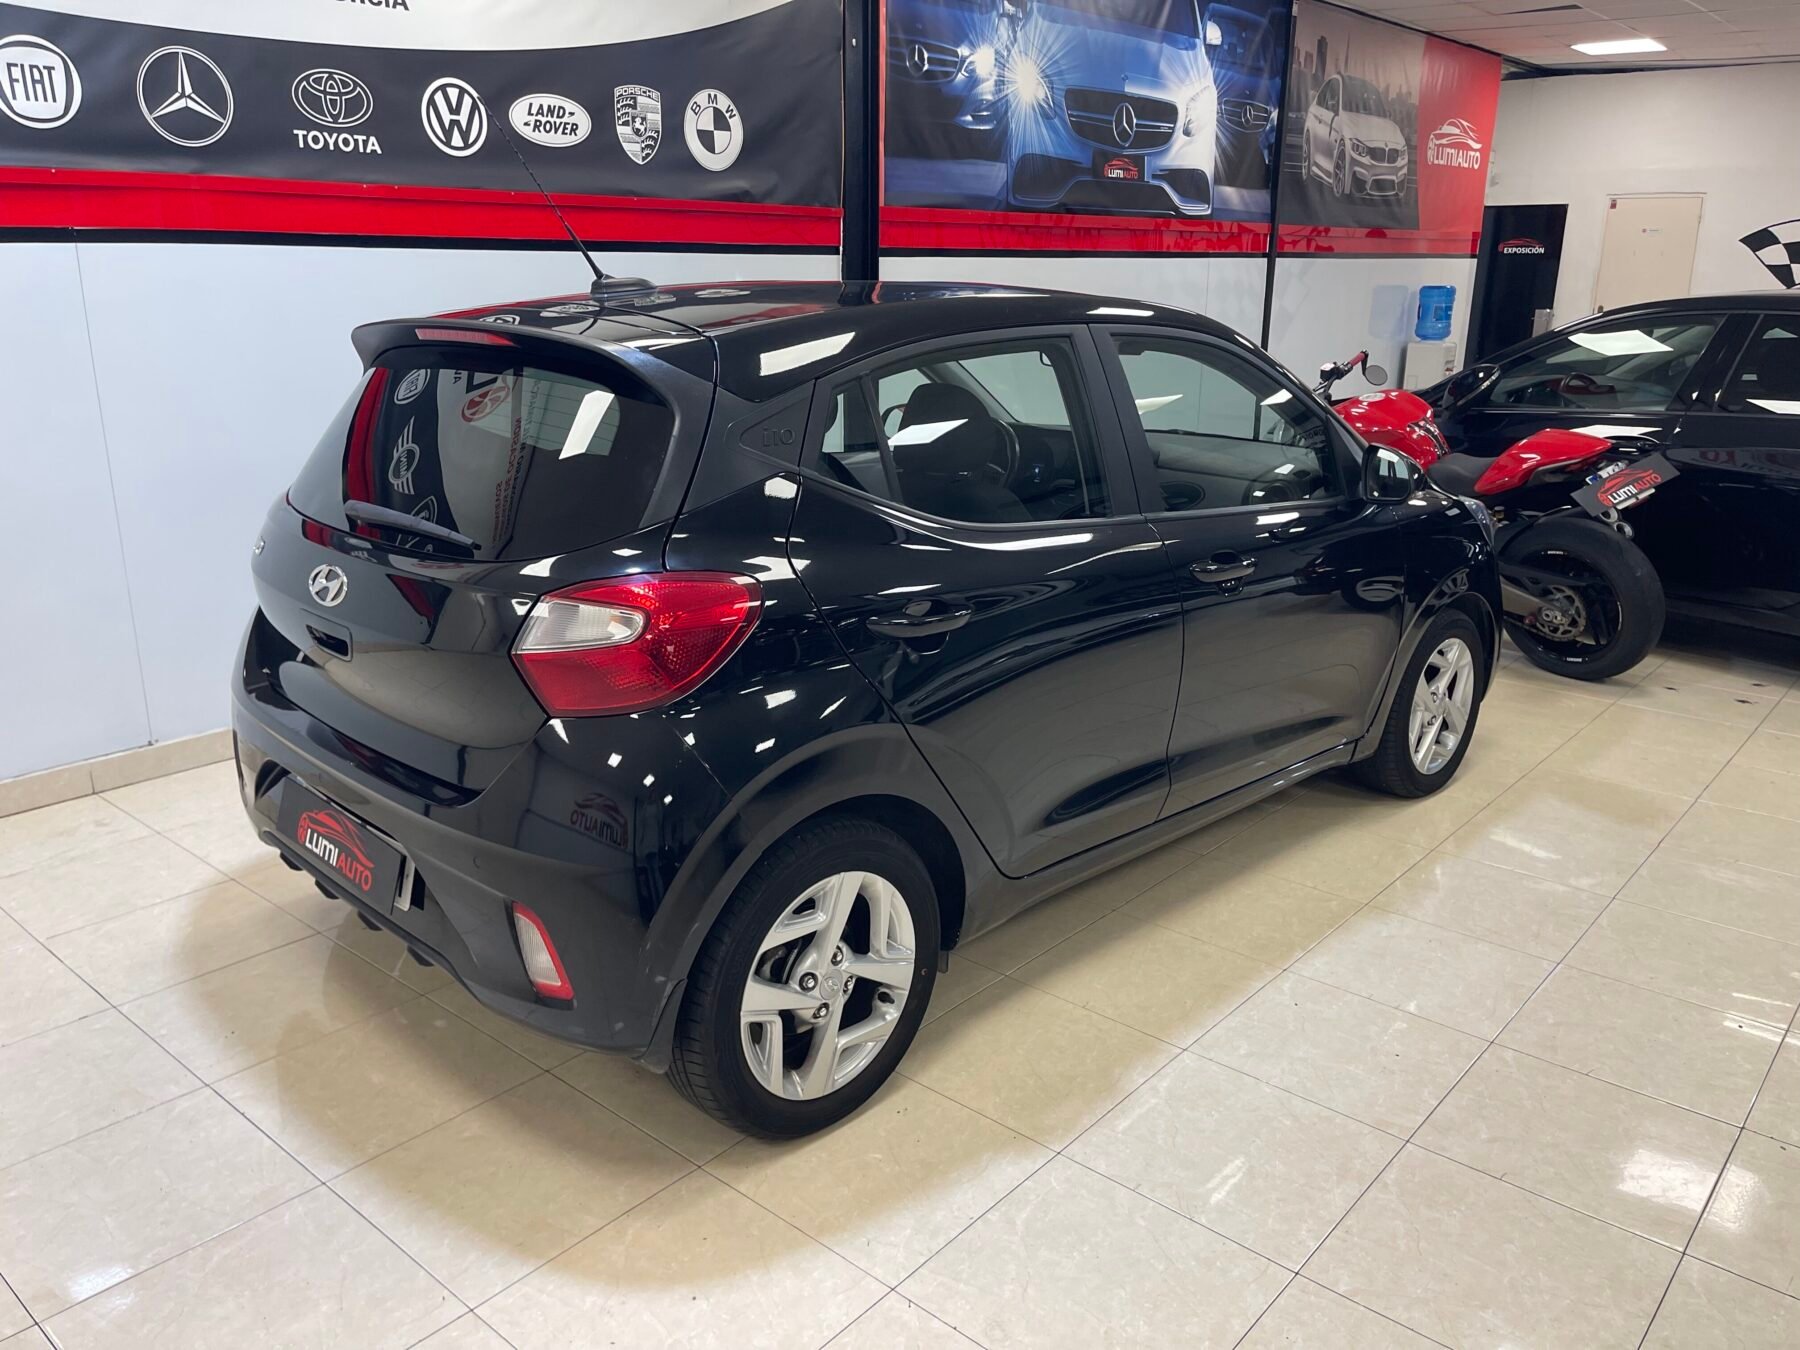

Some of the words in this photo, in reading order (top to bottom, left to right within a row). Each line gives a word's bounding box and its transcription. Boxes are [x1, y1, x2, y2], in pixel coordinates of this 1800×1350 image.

[6, 62, 57, 103] FIAT
[616, 86, 660, 101] PORSCHE
[527, 102, 566, 119] LAND
[690, 92, 736, 119] BMW
[532, 119, 579, 137] ROVER
[293, 129, 382, 154] TOYOTA
